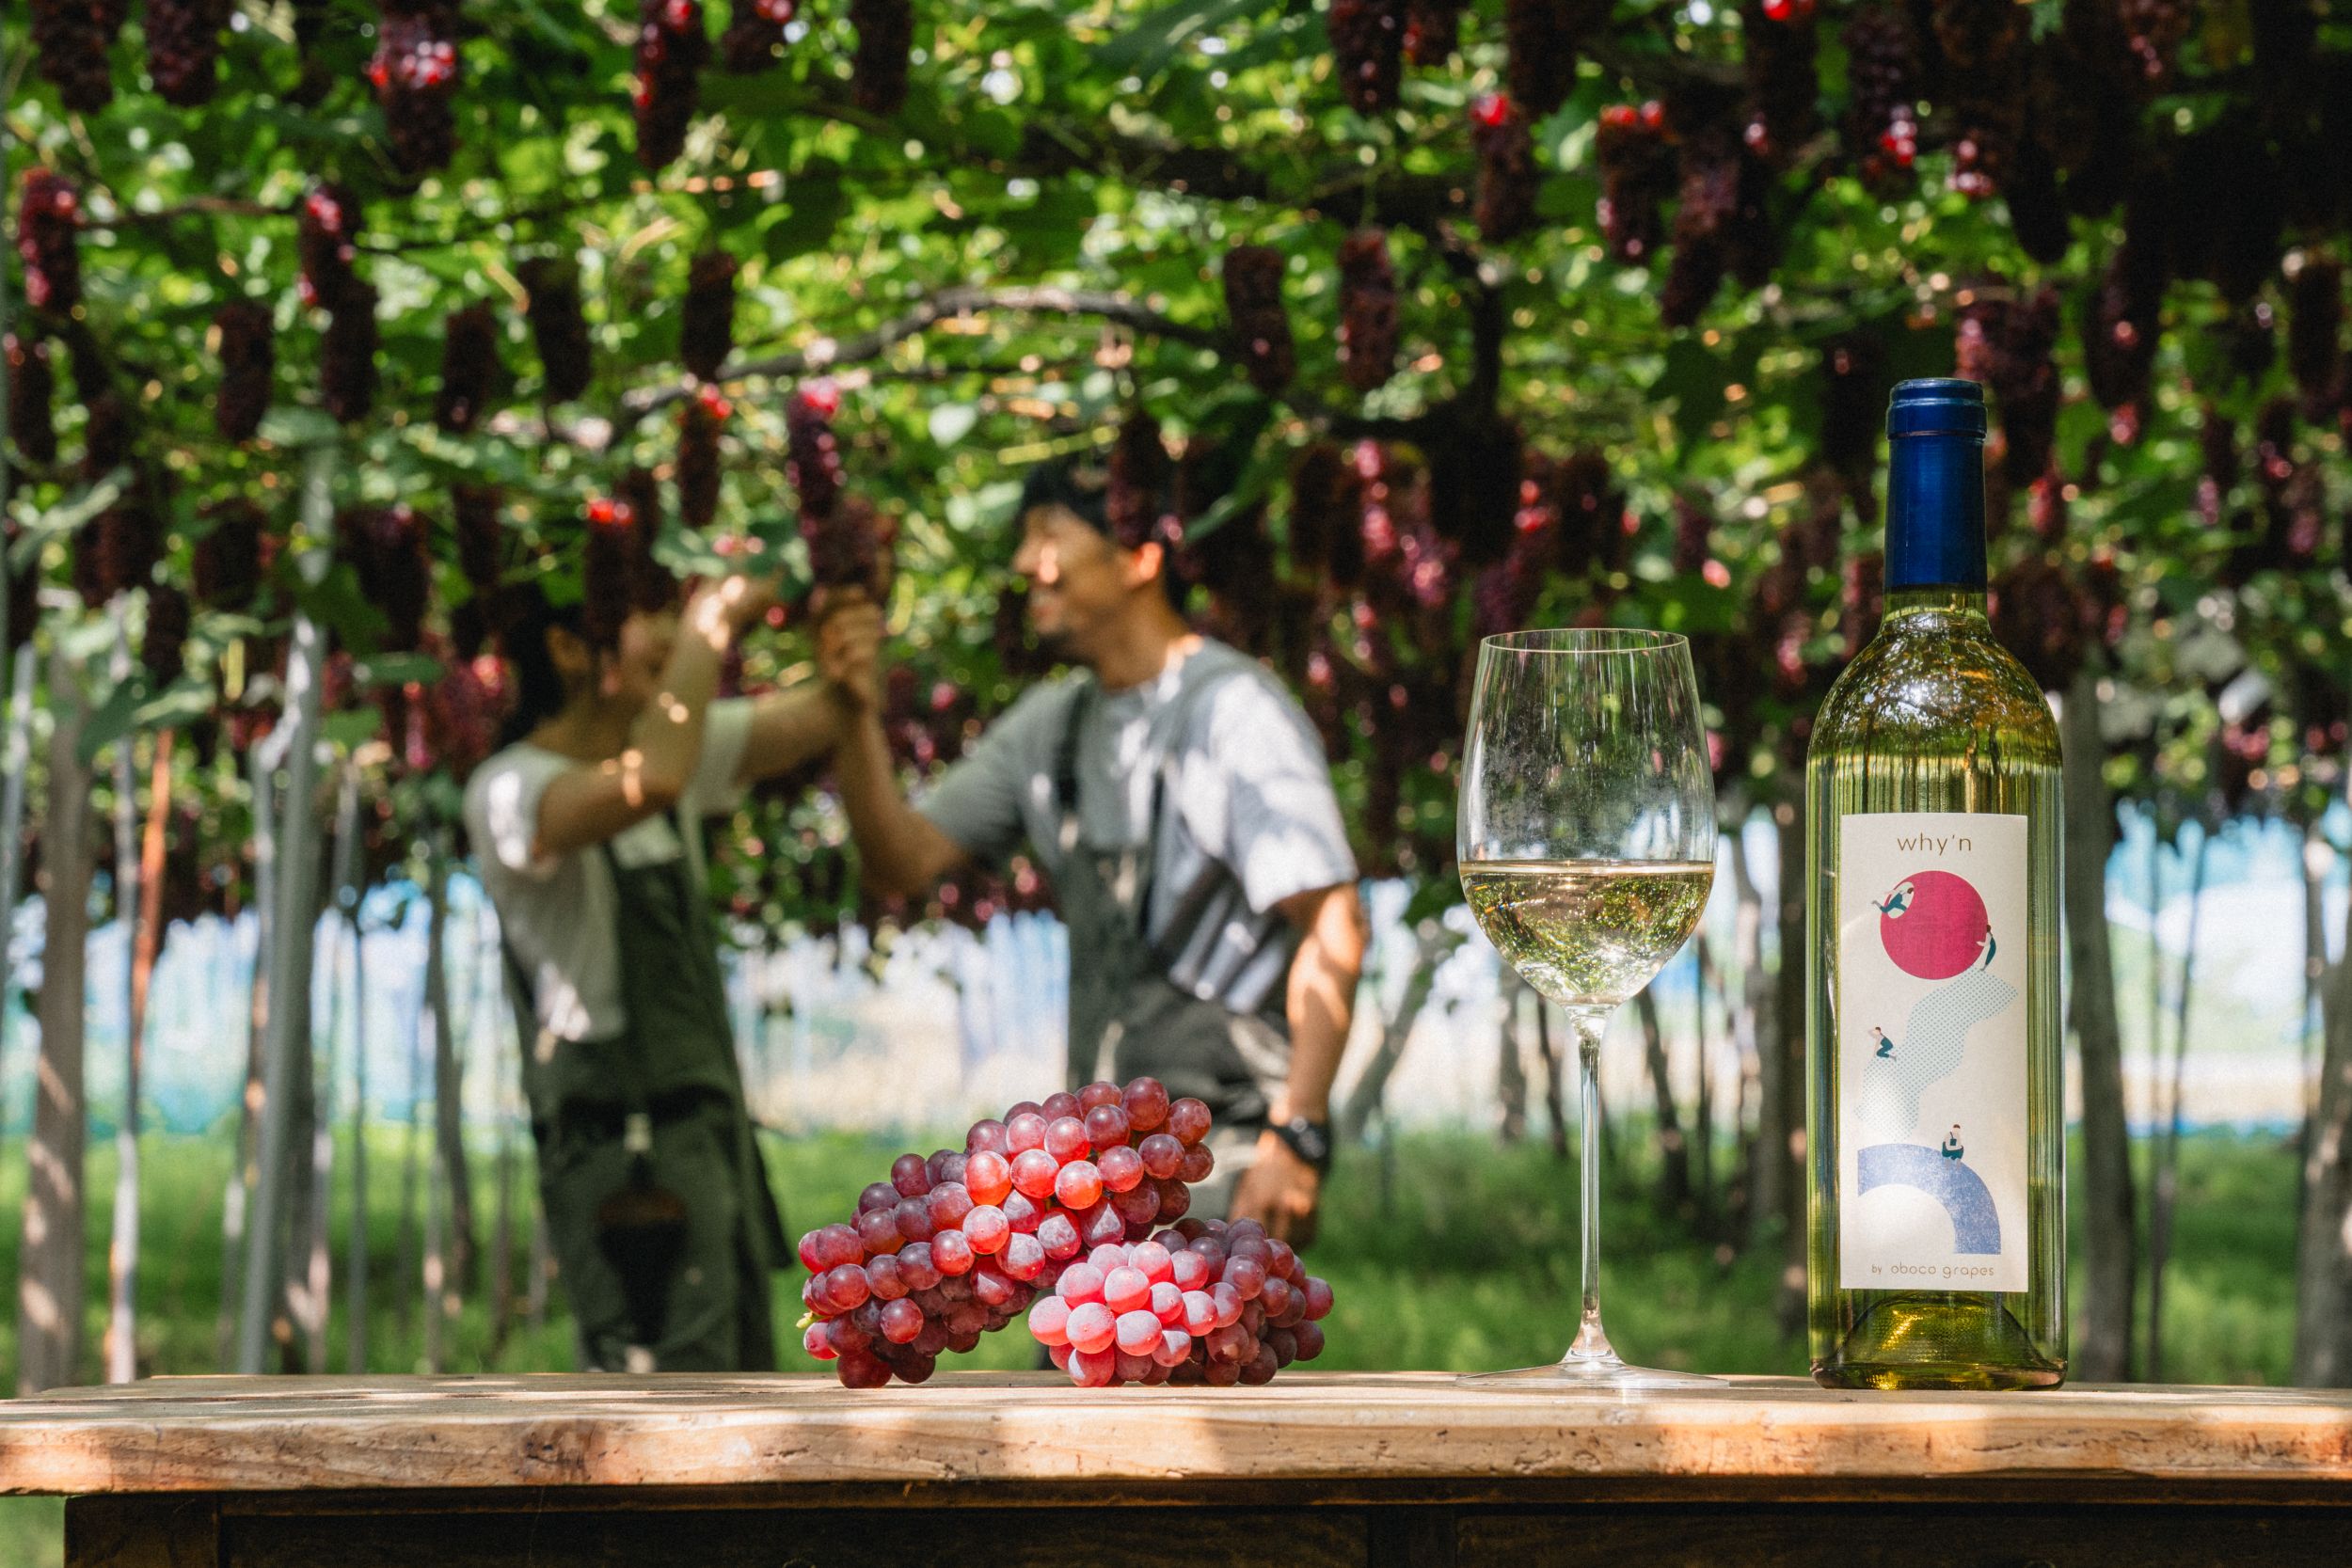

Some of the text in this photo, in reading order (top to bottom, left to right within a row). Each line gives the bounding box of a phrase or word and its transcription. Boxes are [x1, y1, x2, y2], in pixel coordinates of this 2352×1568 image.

[1897, 832, 1972, 856] why'n
[1871, 1260, 1994, 1279] by oboco grapes
